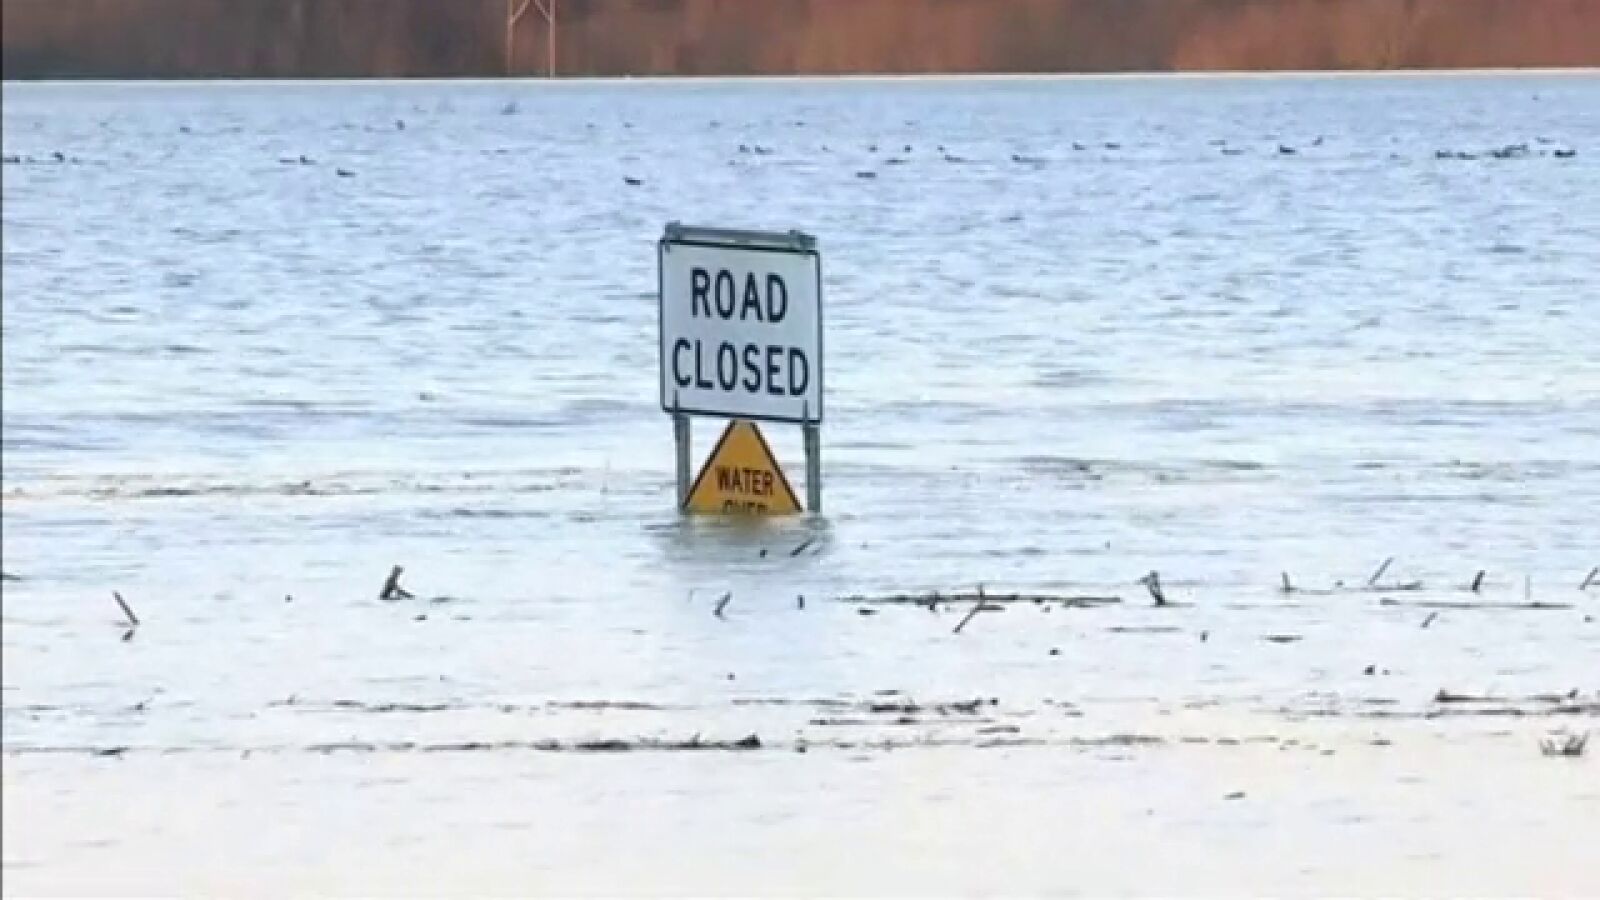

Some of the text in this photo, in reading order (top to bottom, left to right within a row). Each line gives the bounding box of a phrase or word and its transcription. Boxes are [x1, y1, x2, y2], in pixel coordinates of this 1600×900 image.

[690, 267, 788, 323] ROAD
[672, 337, 809, 396] CLOSED
[715, 466, 774, 496] WATER
